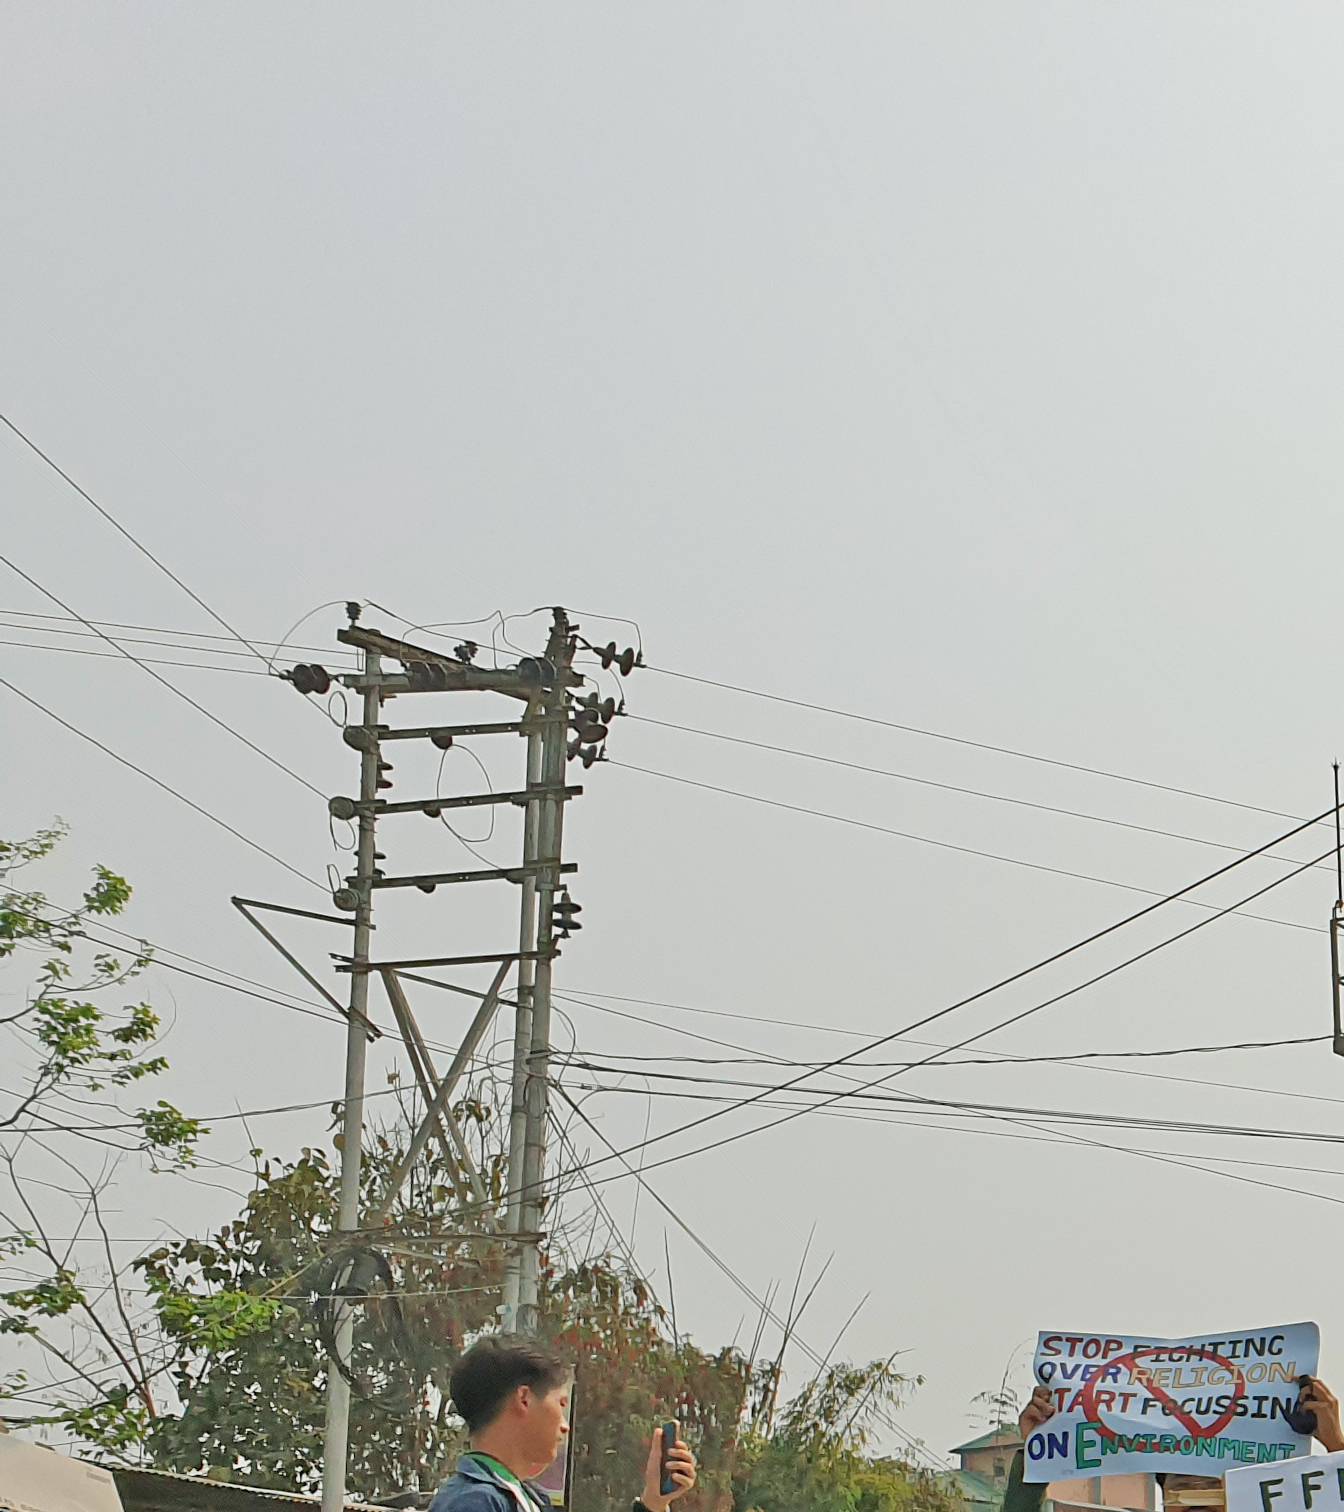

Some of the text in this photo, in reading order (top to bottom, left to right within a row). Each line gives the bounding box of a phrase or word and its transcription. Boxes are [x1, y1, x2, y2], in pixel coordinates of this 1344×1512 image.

[1040, 1336, 1123, 1359] STOP
[1038, 1361, 1297, 1388] OVER RELIGION
[1050, 1388, 1302, 1420] TART FOCUSSIN
[1028, 1431, 1069, 1461] ON
